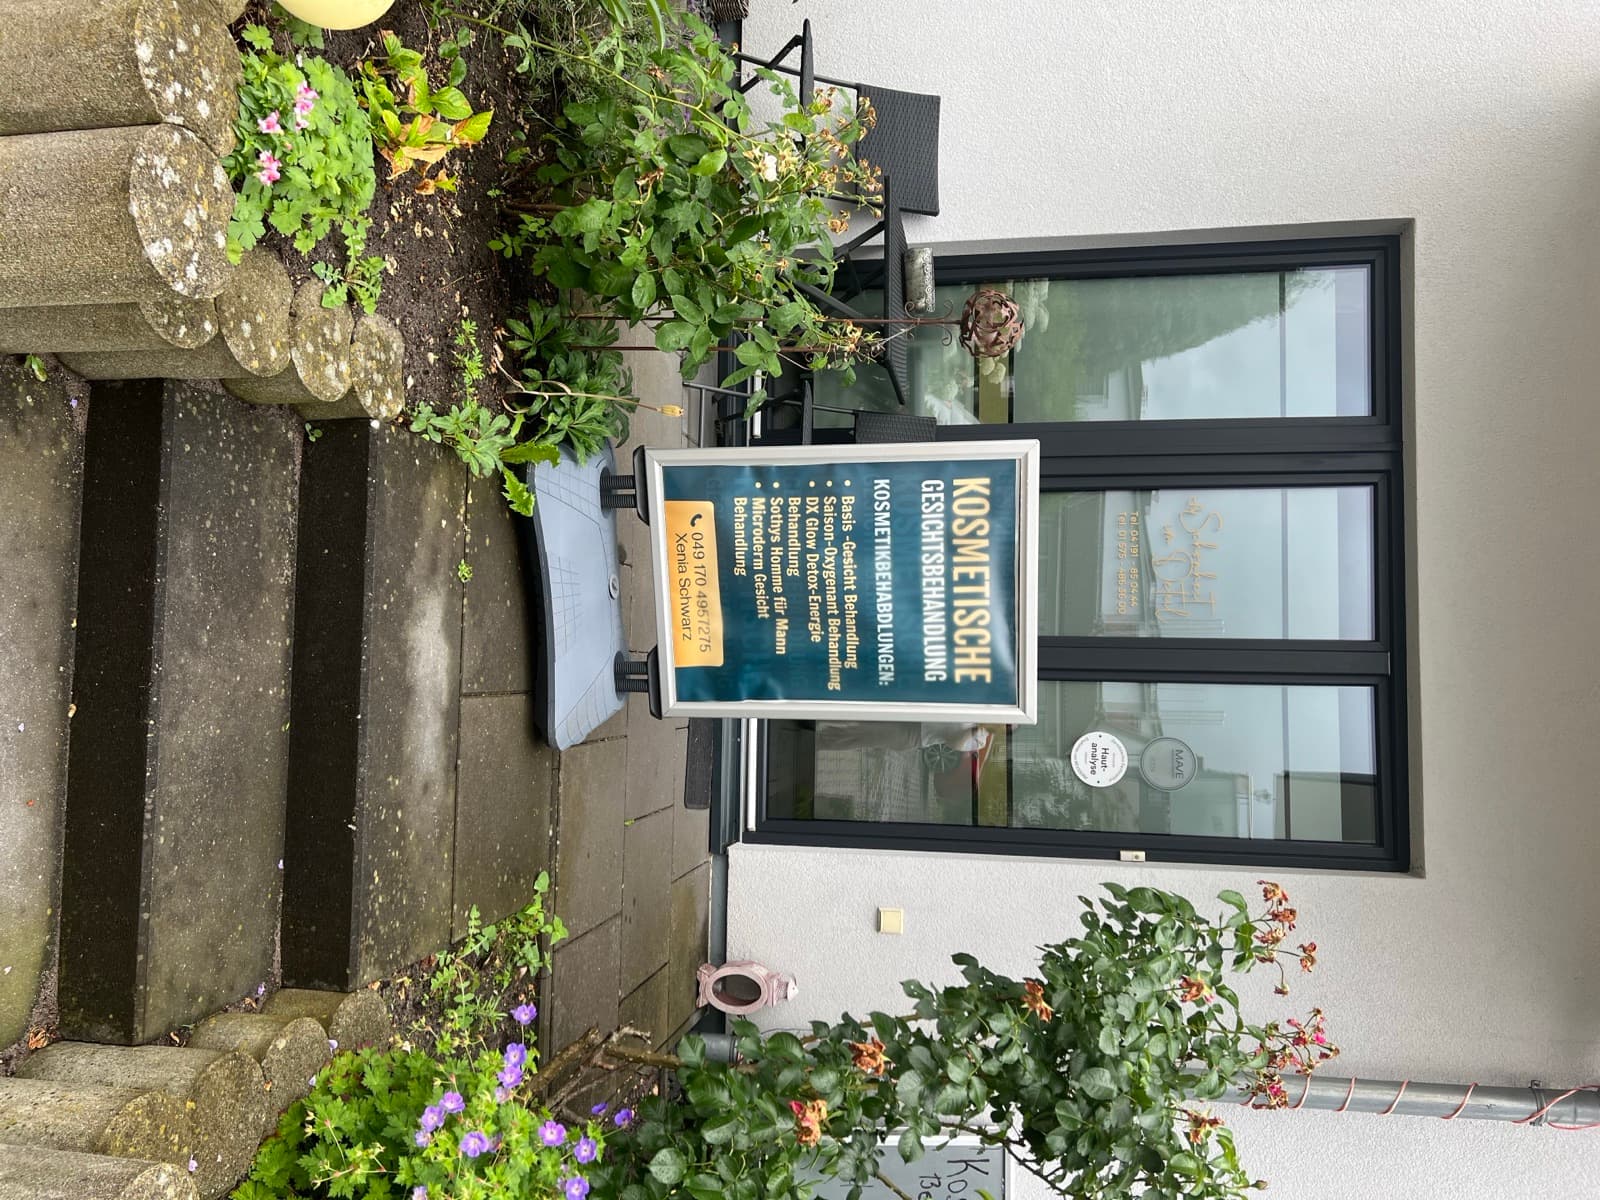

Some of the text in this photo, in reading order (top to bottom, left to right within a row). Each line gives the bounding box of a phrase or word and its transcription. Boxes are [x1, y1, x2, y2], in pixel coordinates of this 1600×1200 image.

[733, 497, 748, 576] Behandlung
[752, 498, 770, 619] Microderm Gesicht
[787, 497, 801, 576] Behandlung
[805, 496, 824, 643] DX Glow Detox-Energie
[840, 496, 856, 532] Basis
[1130, 512, 1138, 527] Tel.
[674, 532, 692, 641] Xenia Schwarz
[691, 532, 712, 652] 049 170 4957275
[768, 496, 788, 654] Sothys Homme für Mann
[822, 496, 842, 691] Saison-Oxygenant Behandlung
[843, 594, 860, 670] Behandlung
[873, 479, 894, 686] KOSMETIKBEHABDLUNGEN:
[921, 480, 947, 682] GESICHTSBEHANDLUNG
[952, 477, 992, 684] KOSMETISCHE
[1089, 742, 1100, 776] analyse
[1100, 748, 1110, 772] Haut-
